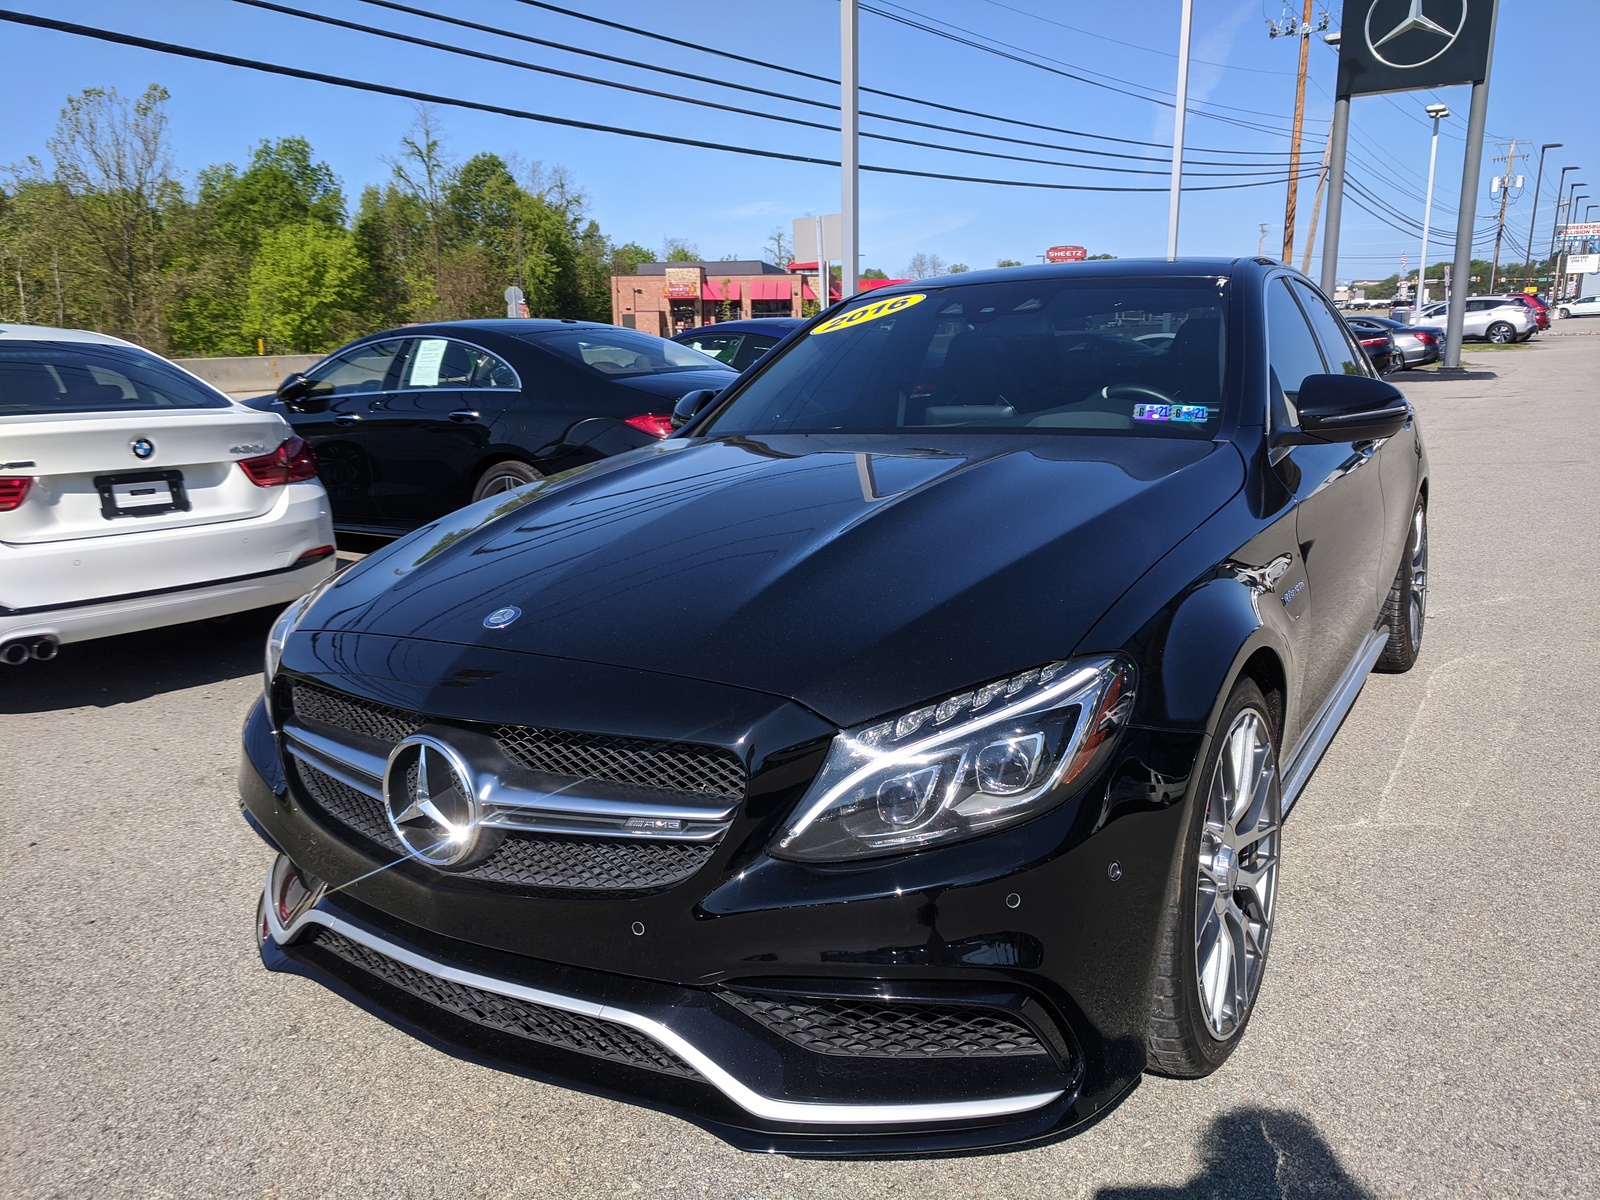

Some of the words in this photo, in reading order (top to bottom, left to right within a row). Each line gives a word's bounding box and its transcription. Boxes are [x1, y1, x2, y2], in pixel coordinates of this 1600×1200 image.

[821, 297, 911, 332] 2016
[1158, 406, 1168, 417] 21
[1195, 407, 1206, 418] 21
